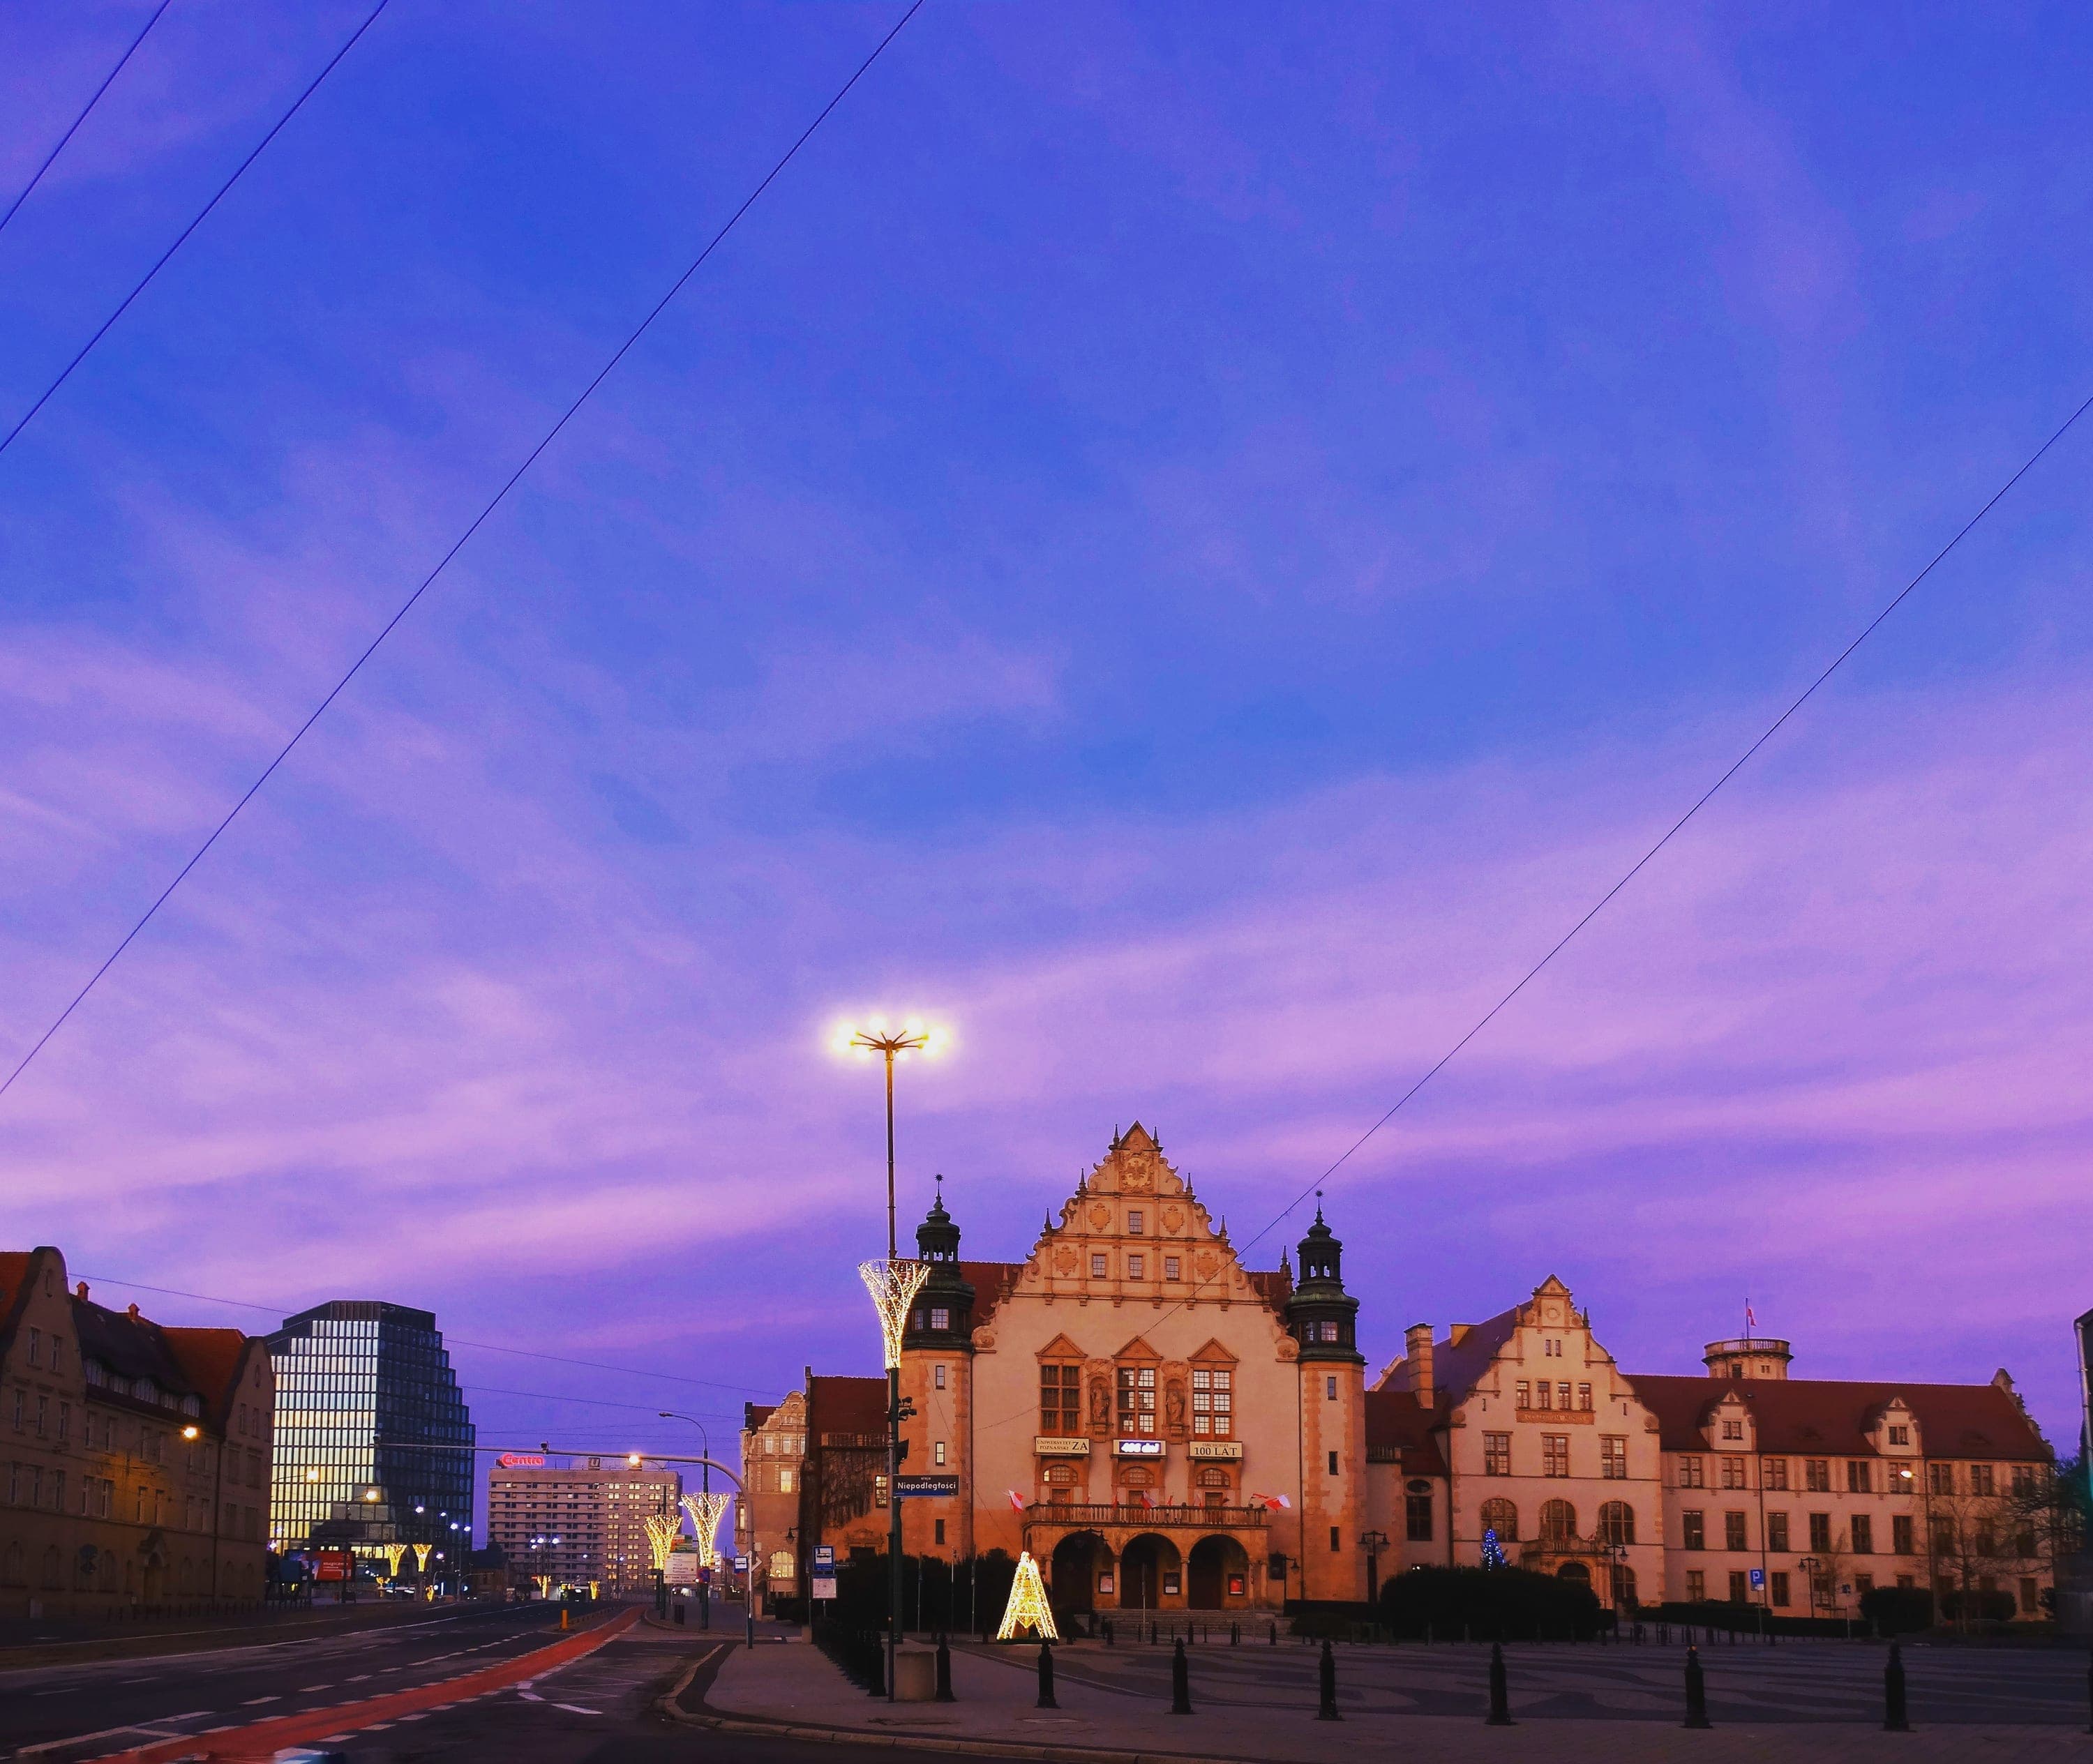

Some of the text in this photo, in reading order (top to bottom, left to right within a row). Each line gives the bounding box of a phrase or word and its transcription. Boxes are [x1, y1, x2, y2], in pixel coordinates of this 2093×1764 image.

[1072, 1441, 1088, 1450] ZA
[1194, 1447, 1237, 1456] 100 LAT
[502, 1454, 543, 1465] Centra
[897, 1482, 956, 1491] Niepodległości
